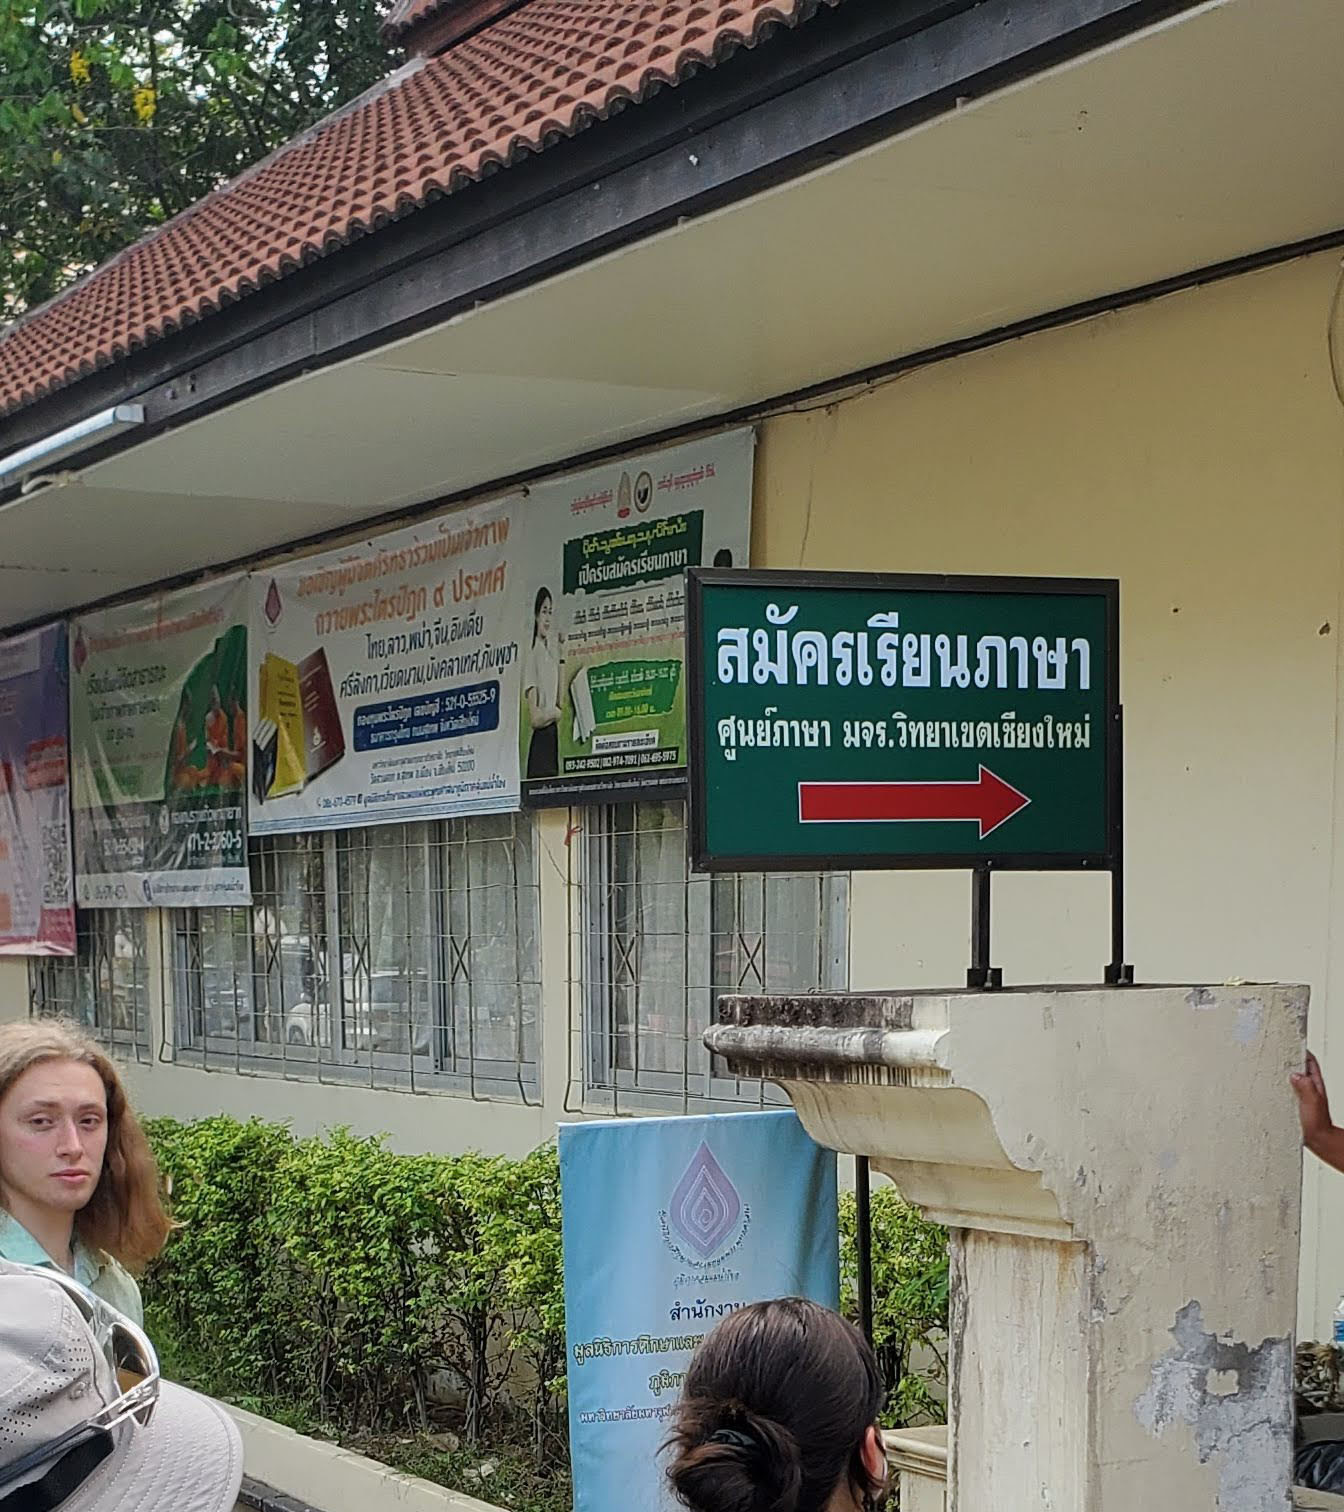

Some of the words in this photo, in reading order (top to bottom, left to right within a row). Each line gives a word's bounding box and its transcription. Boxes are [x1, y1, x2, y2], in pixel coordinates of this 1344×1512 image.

[452, 560, 507, 604] ประเทศ
[716, 602, 1091, 690] สมัครเรียนภาษา
[717, 706, 831, 761] ศูนย์ภาษา
[843, 711, 1091, 750] มจร.วิทยาเขตเชียงใหม่
